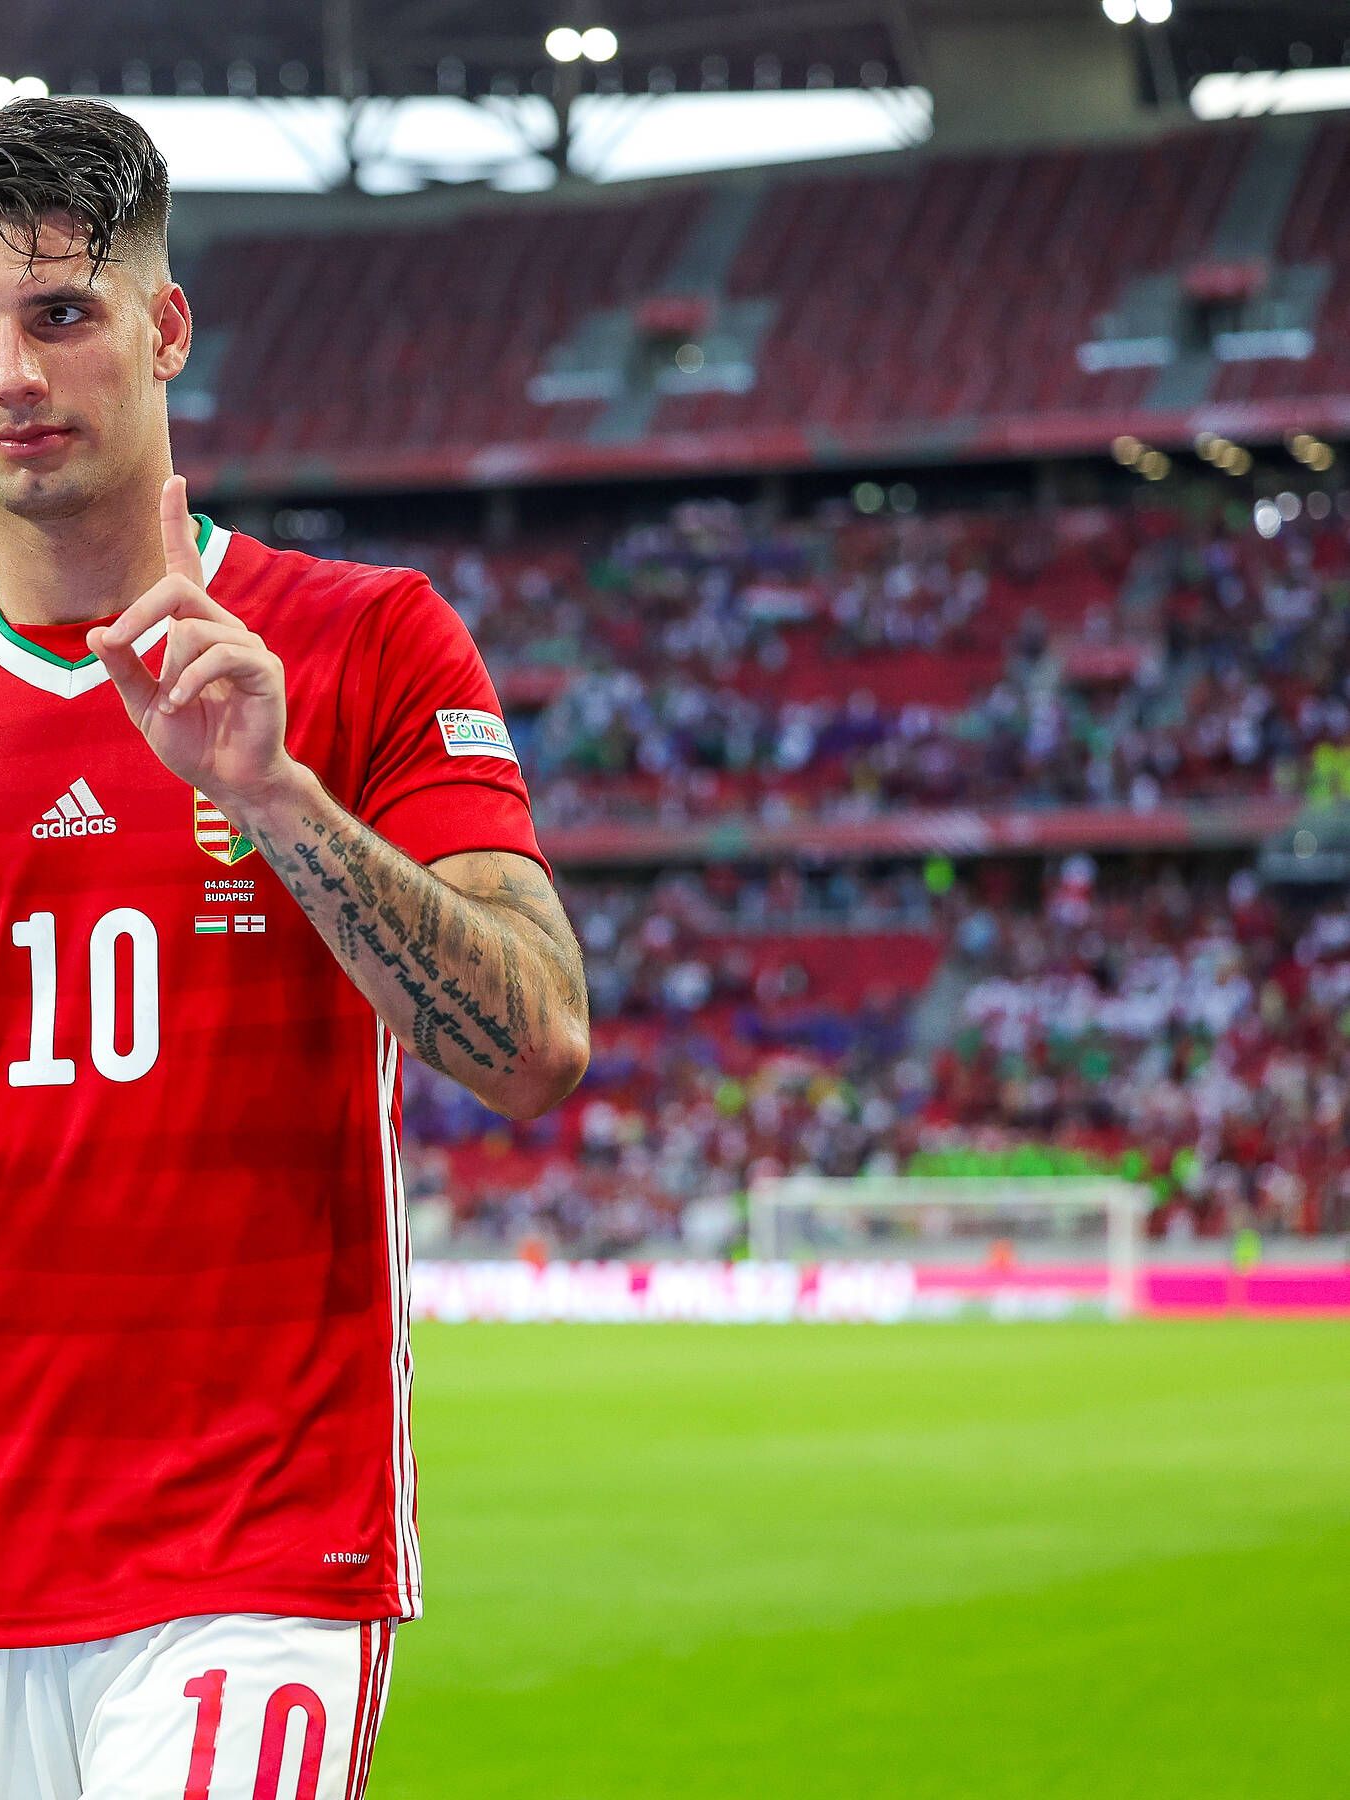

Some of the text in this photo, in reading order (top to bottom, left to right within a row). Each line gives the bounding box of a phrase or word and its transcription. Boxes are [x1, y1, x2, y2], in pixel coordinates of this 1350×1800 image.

[442, 712, 470, 722] UEFA
[31, 816, 117, 839] adidas
[204, 879, 255, 890] 04.06.2022
[205, 892, 255, 902] BUDAPEST
[8, 907, 159, 1087] 10
[183, 1668, 327, 1800] 10
